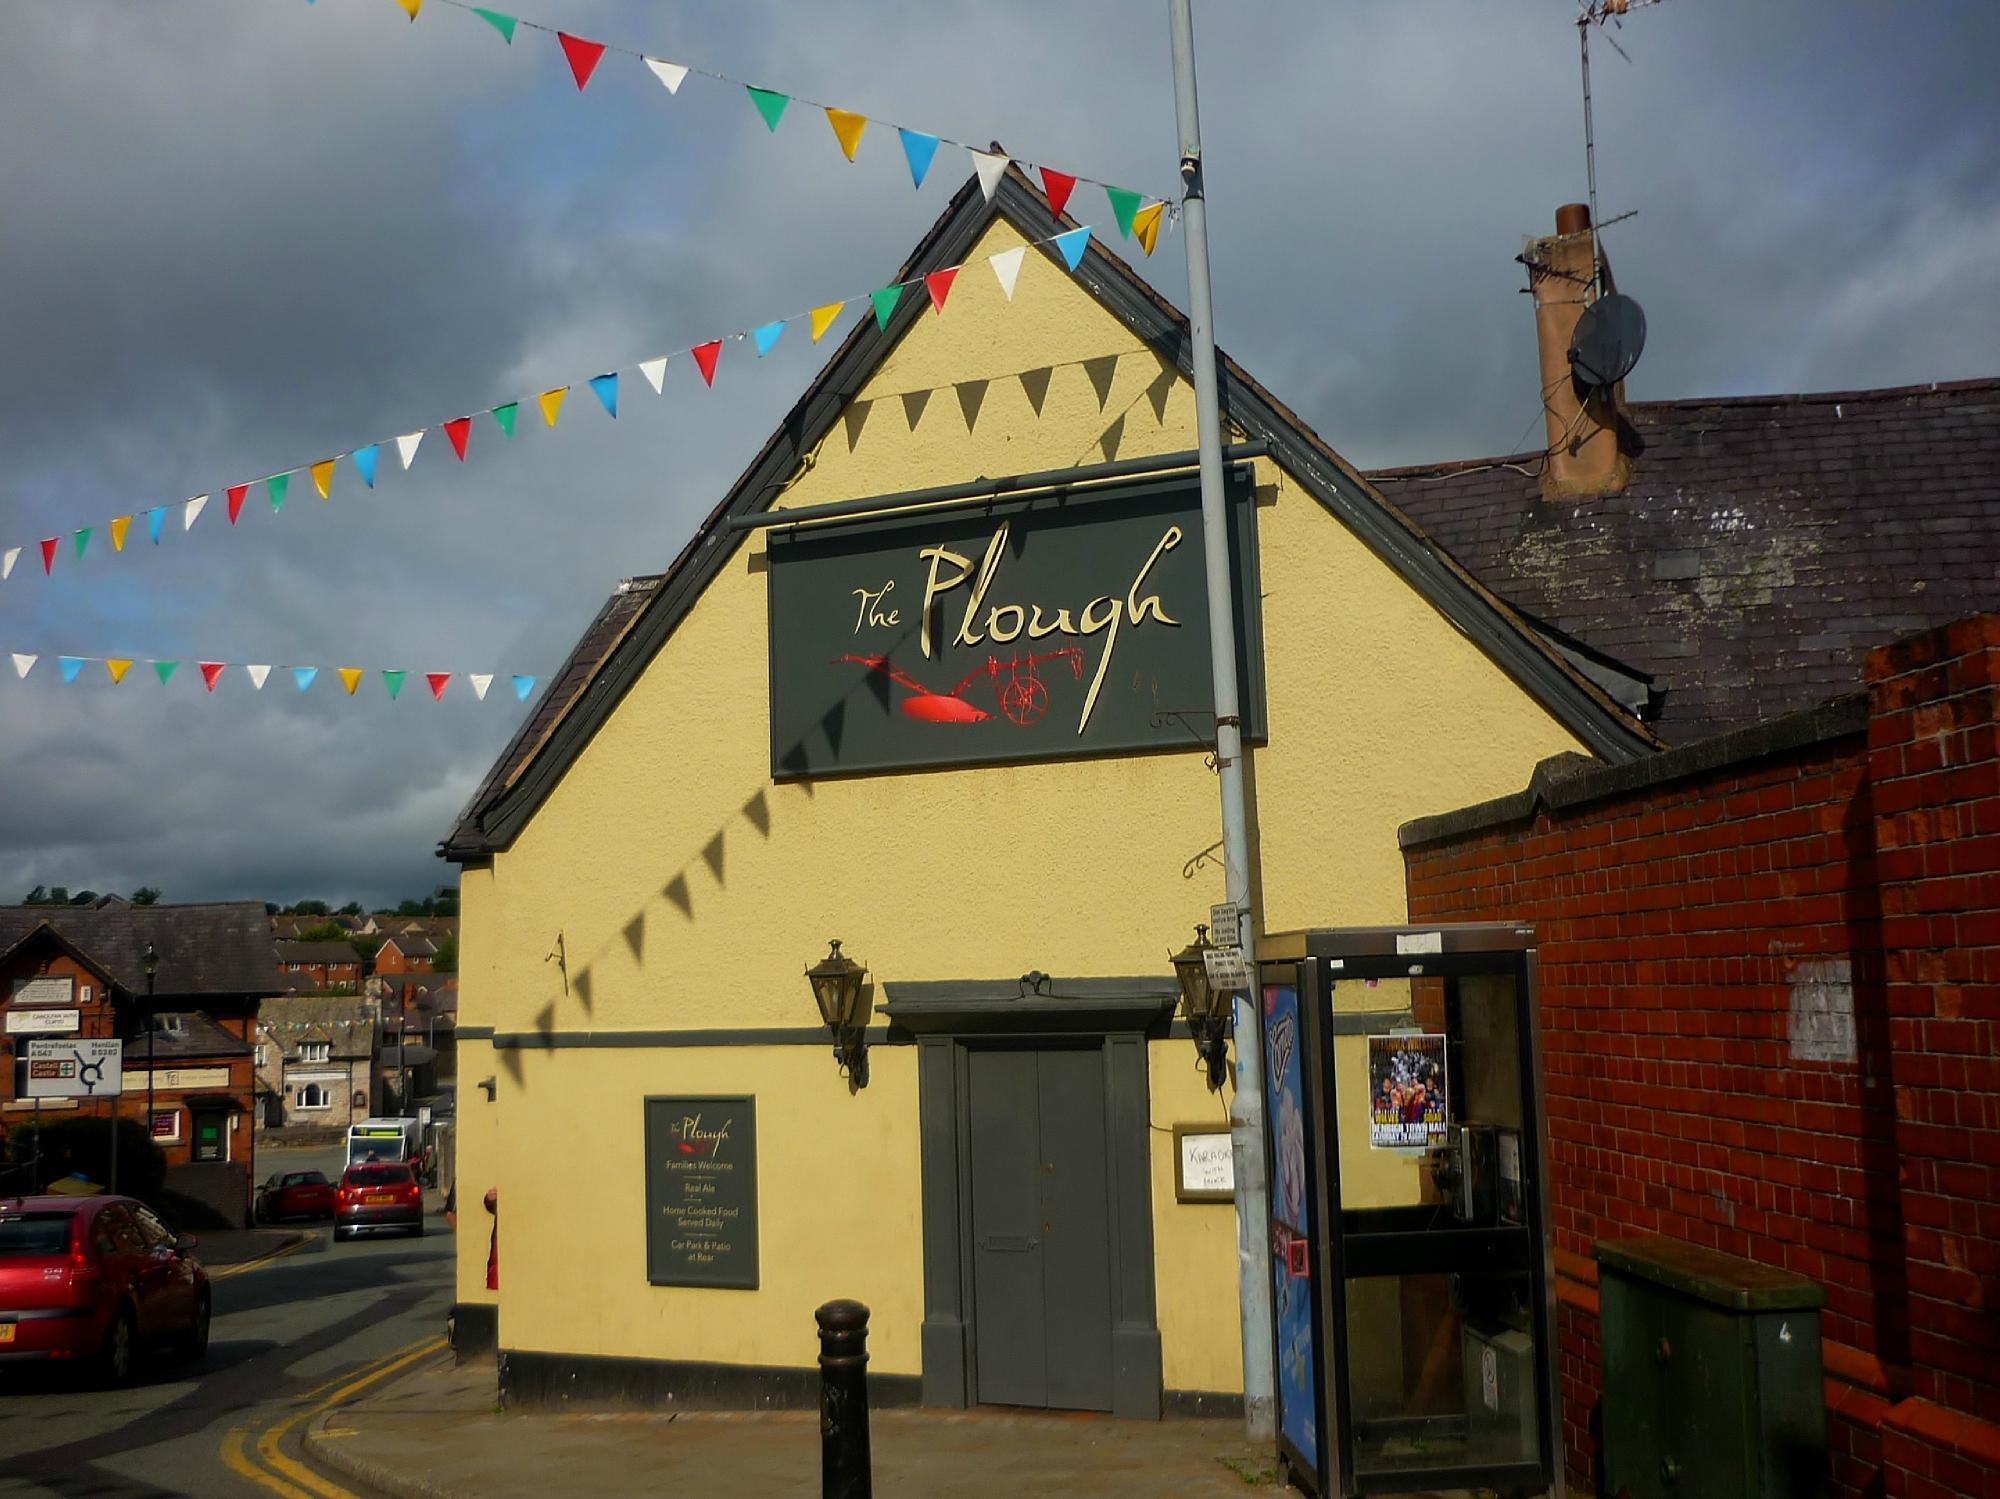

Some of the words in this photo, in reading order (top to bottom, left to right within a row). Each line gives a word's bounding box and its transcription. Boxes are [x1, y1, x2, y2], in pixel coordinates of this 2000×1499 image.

[852, 580, 902, 634] The
[920, 519, 1182, 736] Plough
[32, 1069, 56, 1077] Castle
[683, 1113, 732, 1157] Plough
[666, 1160, 697, 1170] Families
[699, 1160, 733, 1170] Welcome
[685, 1183, 701, 1193] Real
[703, 1183, 716, 1193] Ale
[663, 1206, 686, 1215] Home
[687, 1206, 717, 1216] Cooked
[718, 1206, 739, 1216] Food
[678, 1218, 704, 1227] Served
[705, 1218, 724, 1230] Daily
[671, 1240, 685, 1249] Car
[686, 1240, 702, 1250] Park
[704, 1241, 711, 1249] &
[712, 1241, 731, 1251] Patio
[698, 1252, 715, 1262] Rear
